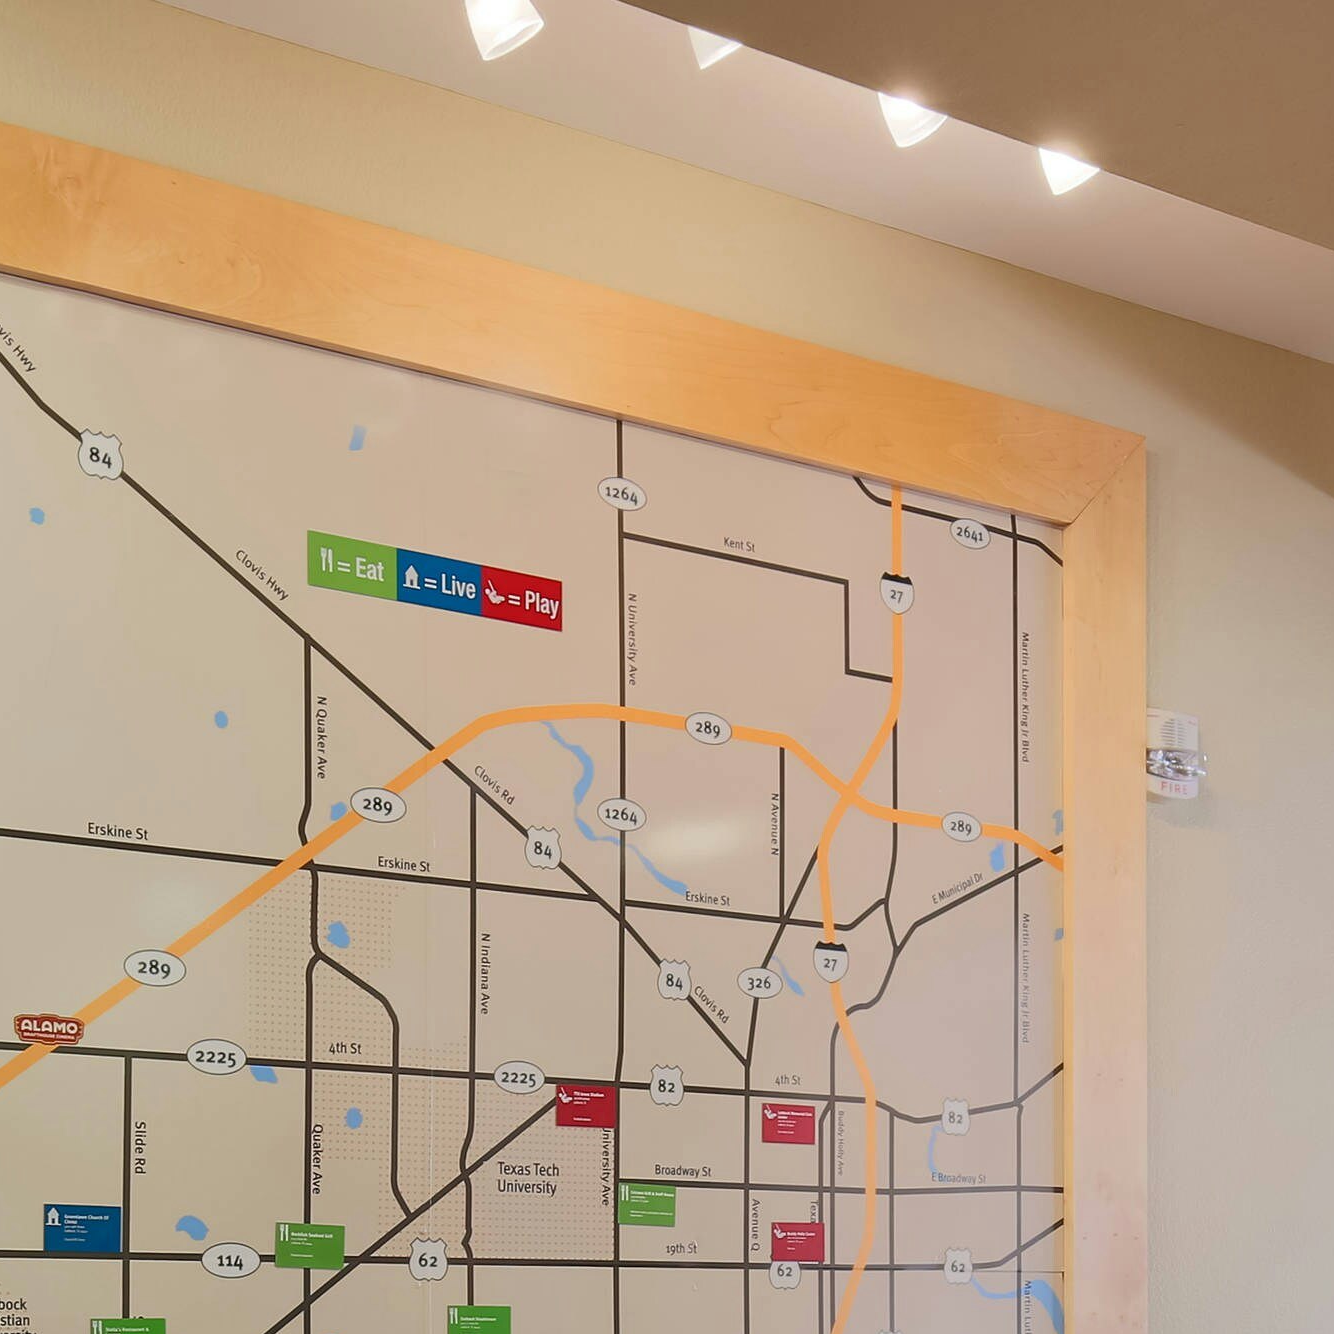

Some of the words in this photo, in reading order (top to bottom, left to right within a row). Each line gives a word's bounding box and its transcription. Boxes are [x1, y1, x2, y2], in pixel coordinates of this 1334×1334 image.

[12, 345, 37, 374] Hwy
[90, 447, 111, 468] 84
[606, 487, 637, 505] 1264
[957, 525, 985, 542] 2641
[724, 537, 742, 549] Kent
[746, 542, 755, 552] St
[234, 548, 264, 579] Clovis
[264, 575, 290, 601] Hwy
[354, 556, 386, 583] Eat
[441, 574, 477, 600] Live
[891, 590, 903, 603] 27
[525, 591, 560, 621] Play
[628, 605, 637, 658] University
[629, 665, 637, 685] Ave
[318, 697, 326, 705] N
[316, 709, 327, 751] Quaker
[696, 721, 720, 738] 289
[317, 757, 327, 779] Ave
[363, 797, 392, 815] 289
[88, 822, 128, 840] Erskine
[131, 828, 147, 840] St
[534, 841, 552, 859] 84
[378, 857, 416, 872] Erskine
[420, 861, 429, 872] St
[138, 960, 170, 979] 289
[481, 946, 490, 989] Indiana
[748, 976, 771, 990] 326
[481, 993, 490, 1014] Ave
[21, 1019, 78, 1034] ALAMO
[329, 1042, 347, 1054] 4th
[351, 1043, 361, 1054] St
[194, 1051, 236, 1069] 2225
[658, 1079, 674, 1092] 82
[135, 1122, 146, 1153] Slide
[135, 1158, 146, 1173] Rd
[498, 1162, 529, 1175] Texas
[533, 1163, 559, 1176] Tech
[654, 1164, 698, 1179] Broadway
[702, 1167, 711, 1176] St
[498, 1179, 556, 1197] University
[218, 1255, 243, 1270] 114
[419, 1253, 437, 1267] 62
